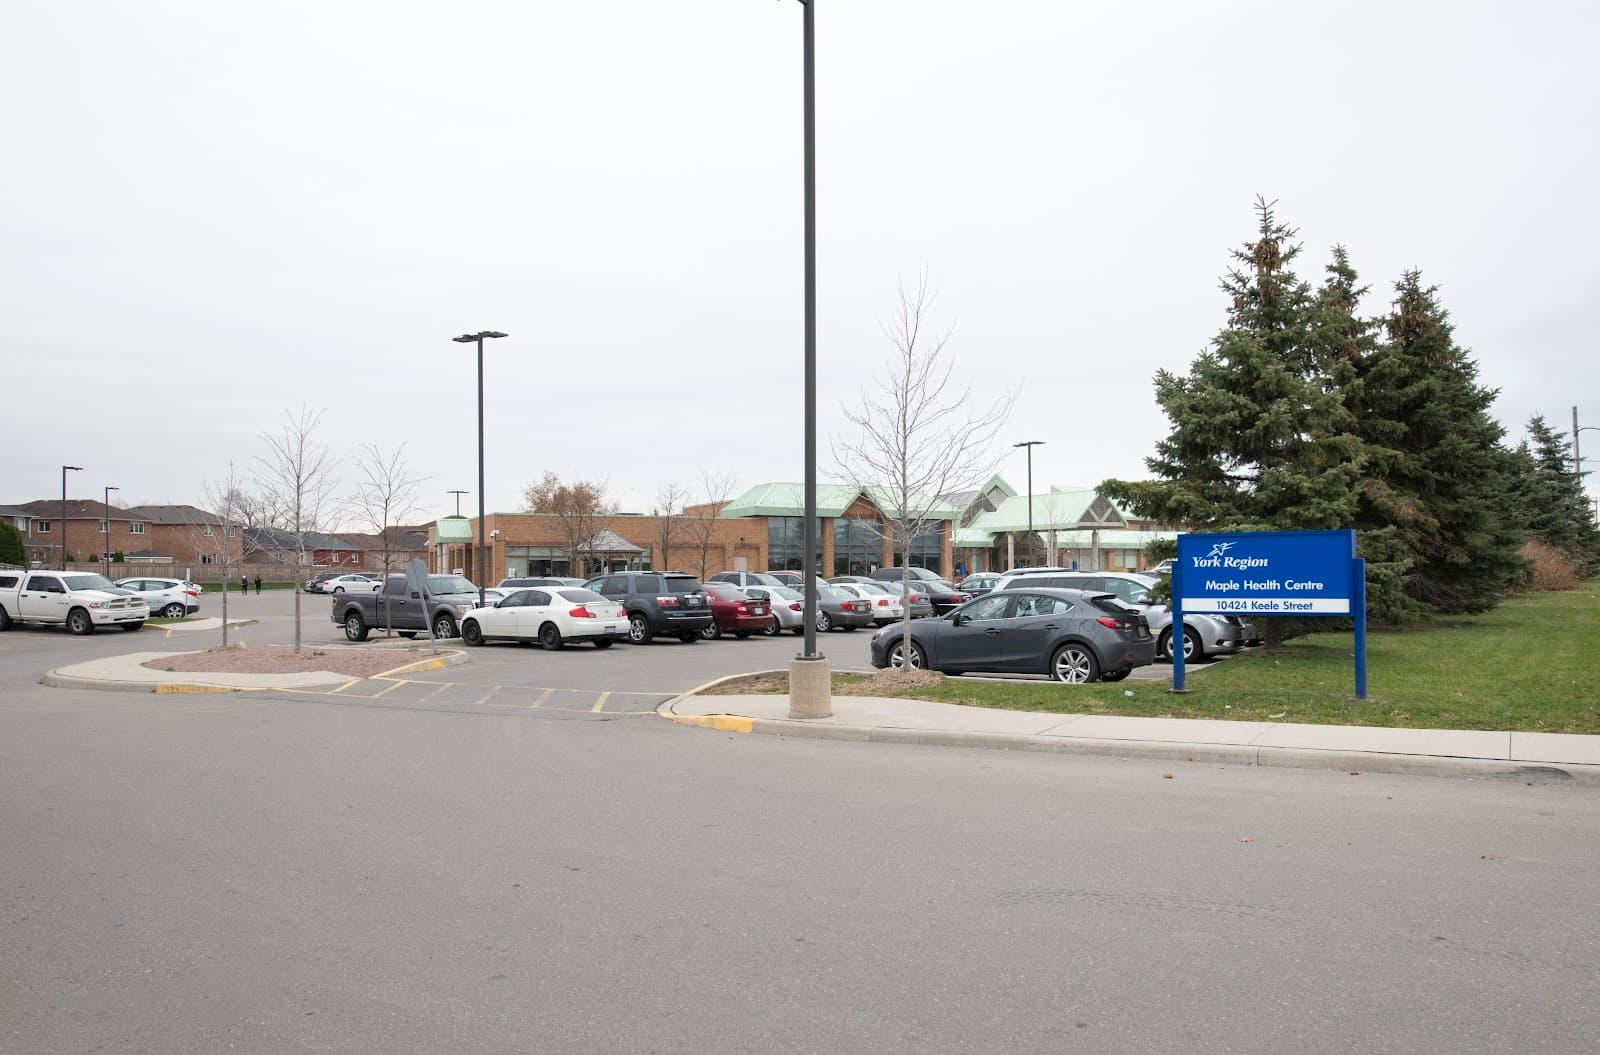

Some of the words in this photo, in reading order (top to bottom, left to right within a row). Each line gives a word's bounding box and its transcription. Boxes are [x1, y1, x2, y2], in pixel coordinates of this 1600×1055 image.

[1192, 556, 1221, 568] York
[1224, 556, 1269, 571] Region
[1205, 580, 1240, 593] Maple
[1243, 579, 1281, 591] Health
[1285, 579, 1324, 591] Centre
[1217, 600, 1248, 611] 10424
[1251, 600, 1280, 611] Keele
[1283, 600, 1314, 611] Street
